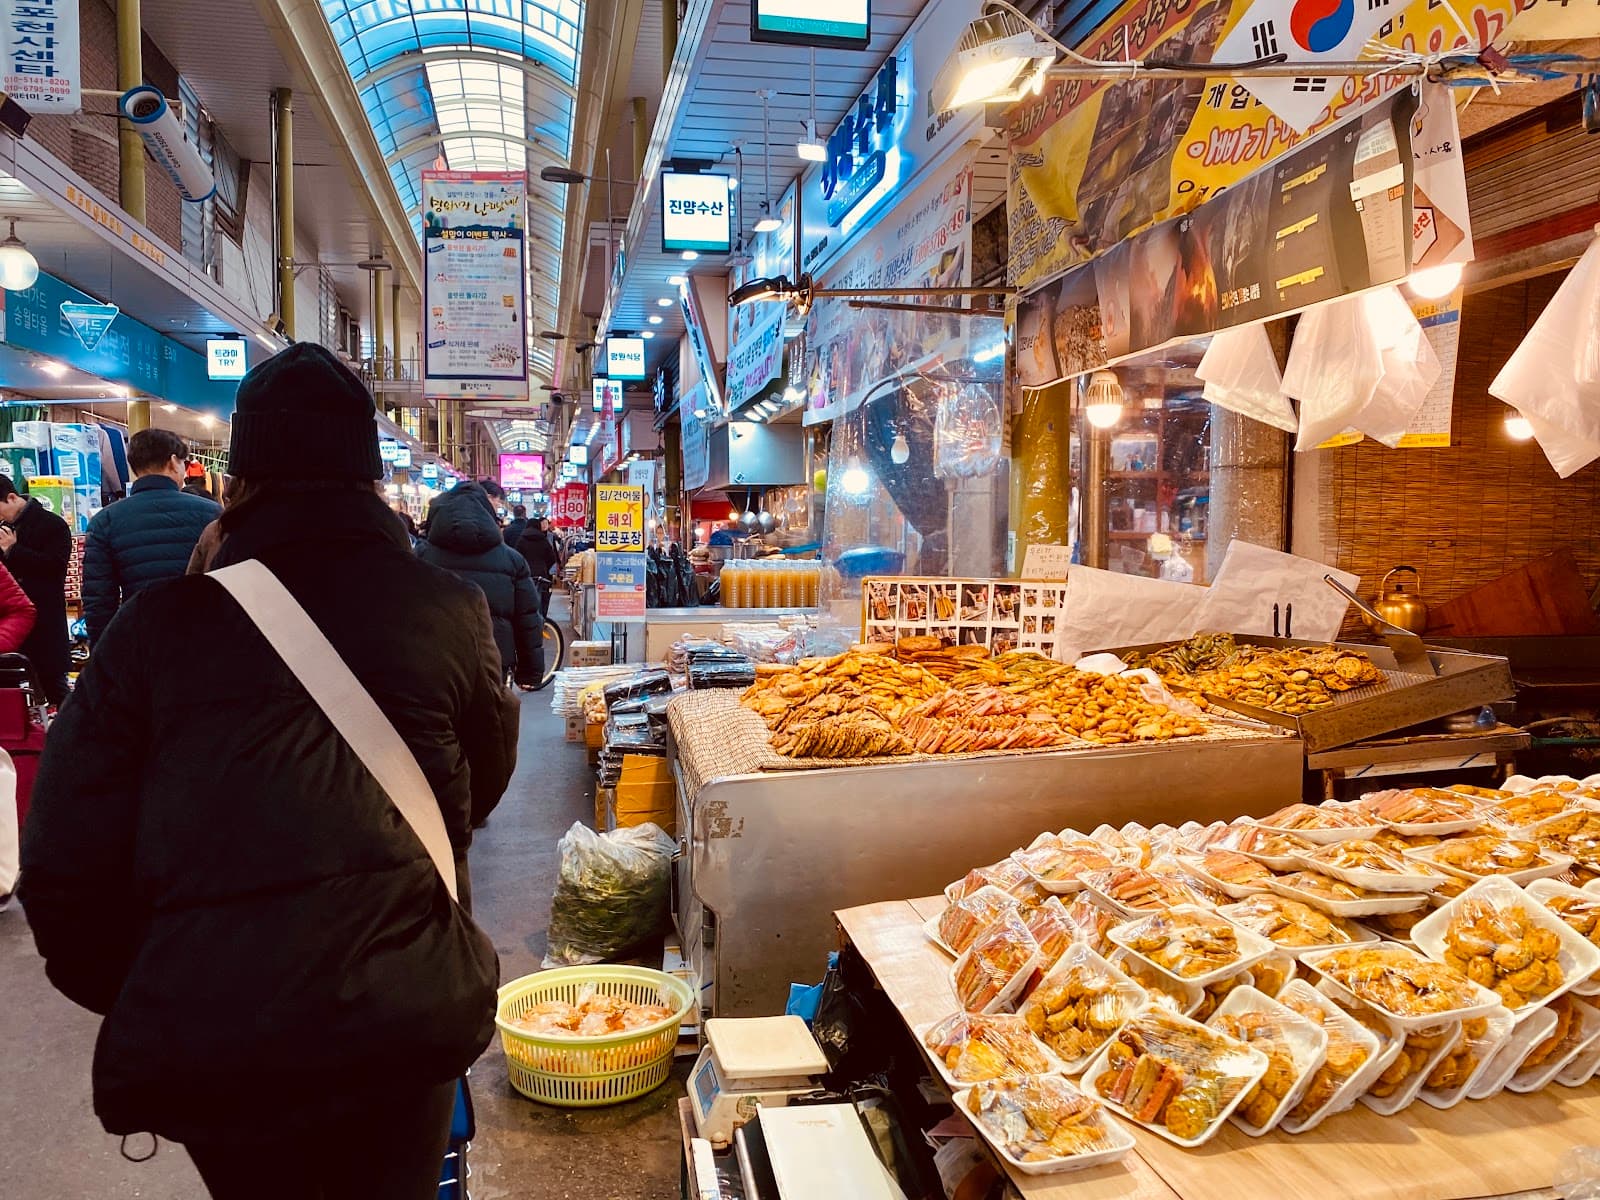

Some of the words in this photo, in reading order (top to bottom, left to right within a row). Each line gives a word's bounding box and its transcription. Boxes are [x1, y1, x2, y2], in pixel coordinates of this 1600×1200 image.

[9, 0, 60, 77] 포천사센타
[1206, 82, 1263, 110] 개업
[1186, 114, 1281, 168] 아빠가
[669, 199, 724, 216] 진양수산
[466, 229, 489, 240] 이벤트
[491, 230, 507, 241] 행사
[77, 318, 102, 331] 카드
[215, 349, 238, 358] 트라이
[217, 359, 236, 367] TRY
[599, 490, 641, 502] 김/건어물
[567, 502, 583, 513] 80
[607, 512, 632, 528] 해외
[598, 530, 642, 547] 진공포장
[608, 573, 634, 584] 구운김
